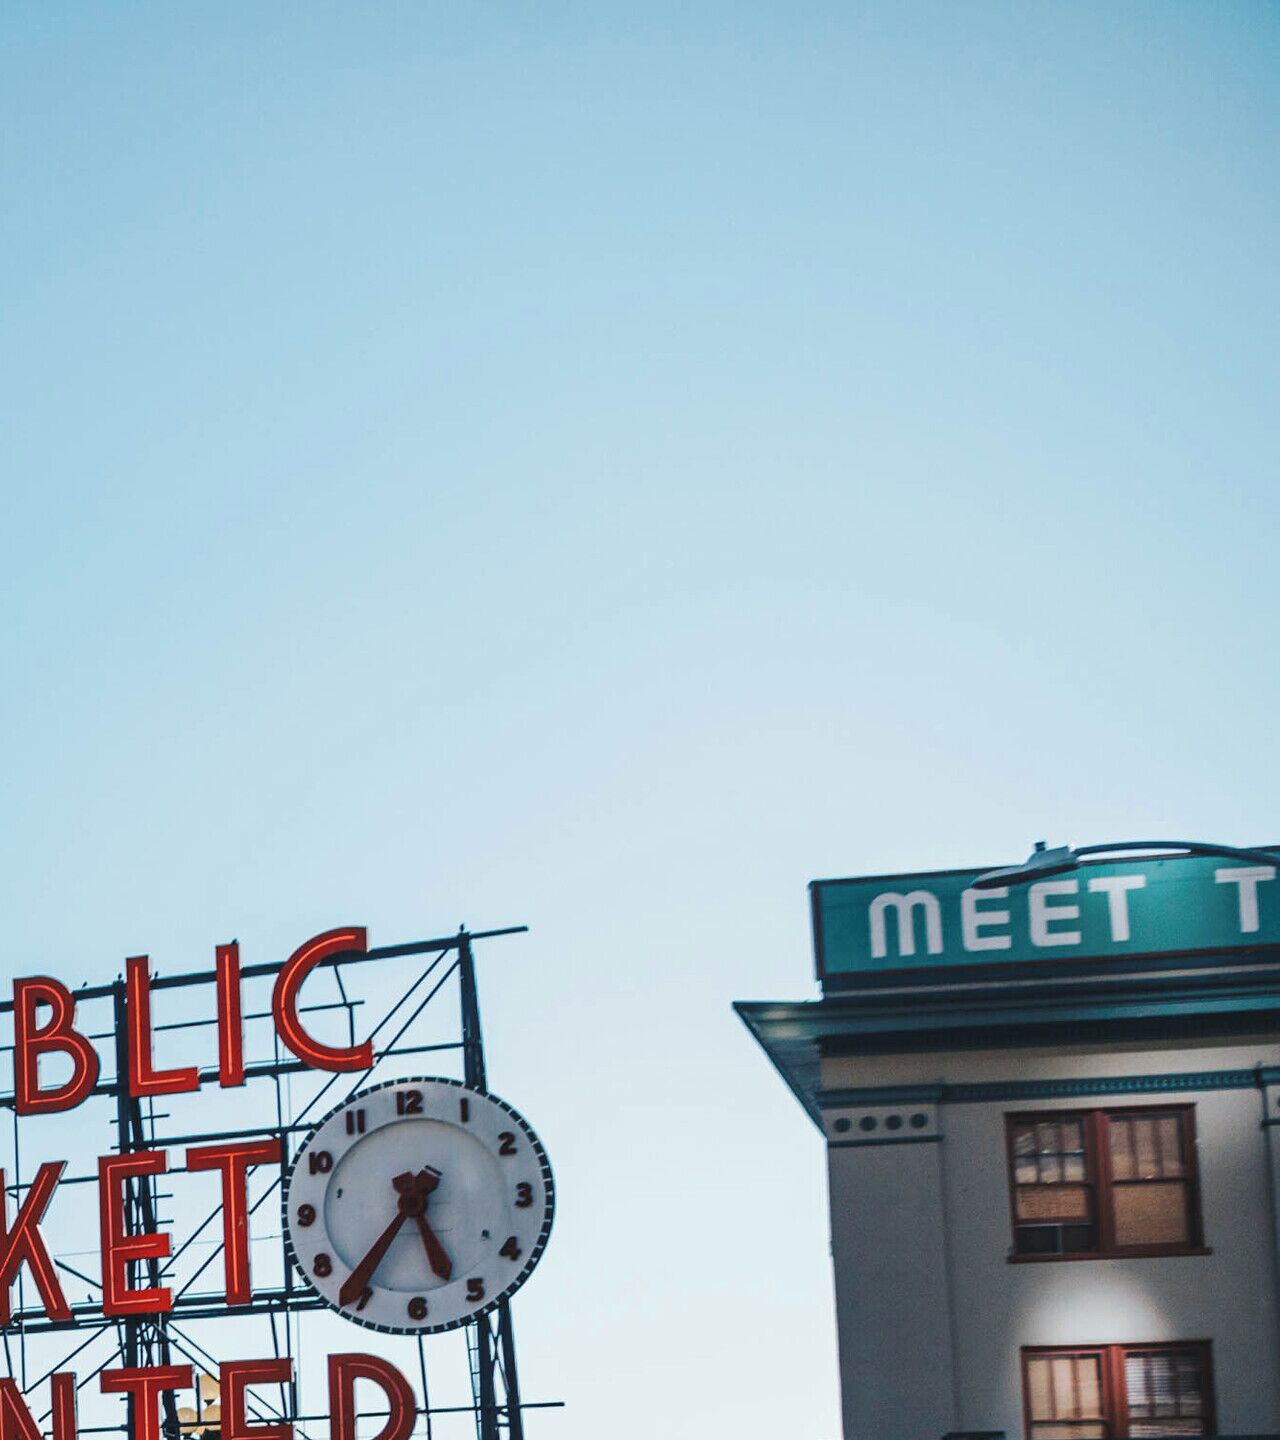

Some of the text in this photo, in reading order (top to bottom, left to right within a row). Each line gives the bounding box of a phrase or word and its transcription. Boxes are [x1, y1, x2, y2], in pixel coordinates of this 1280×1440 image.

[869, 866, 1276, 959] MEET T
[396, 1090, 424, 1116] 12
[460, 1097, 469, 1123] 1
[346, 1109, 366, 1135] 11
[498, 1132, 517, 1156] 2
[309, 1151, 333, 1175] 10
[515, 1182, 533, 1208] 3
[297, 1204, 316, 1228] 9
[499, 1236, 522, 1261] 4
[313, 1253, 333, 1278] 8
[466, 1278, 485, 1302] 5
[408, 1297, 428, 1321] 6
